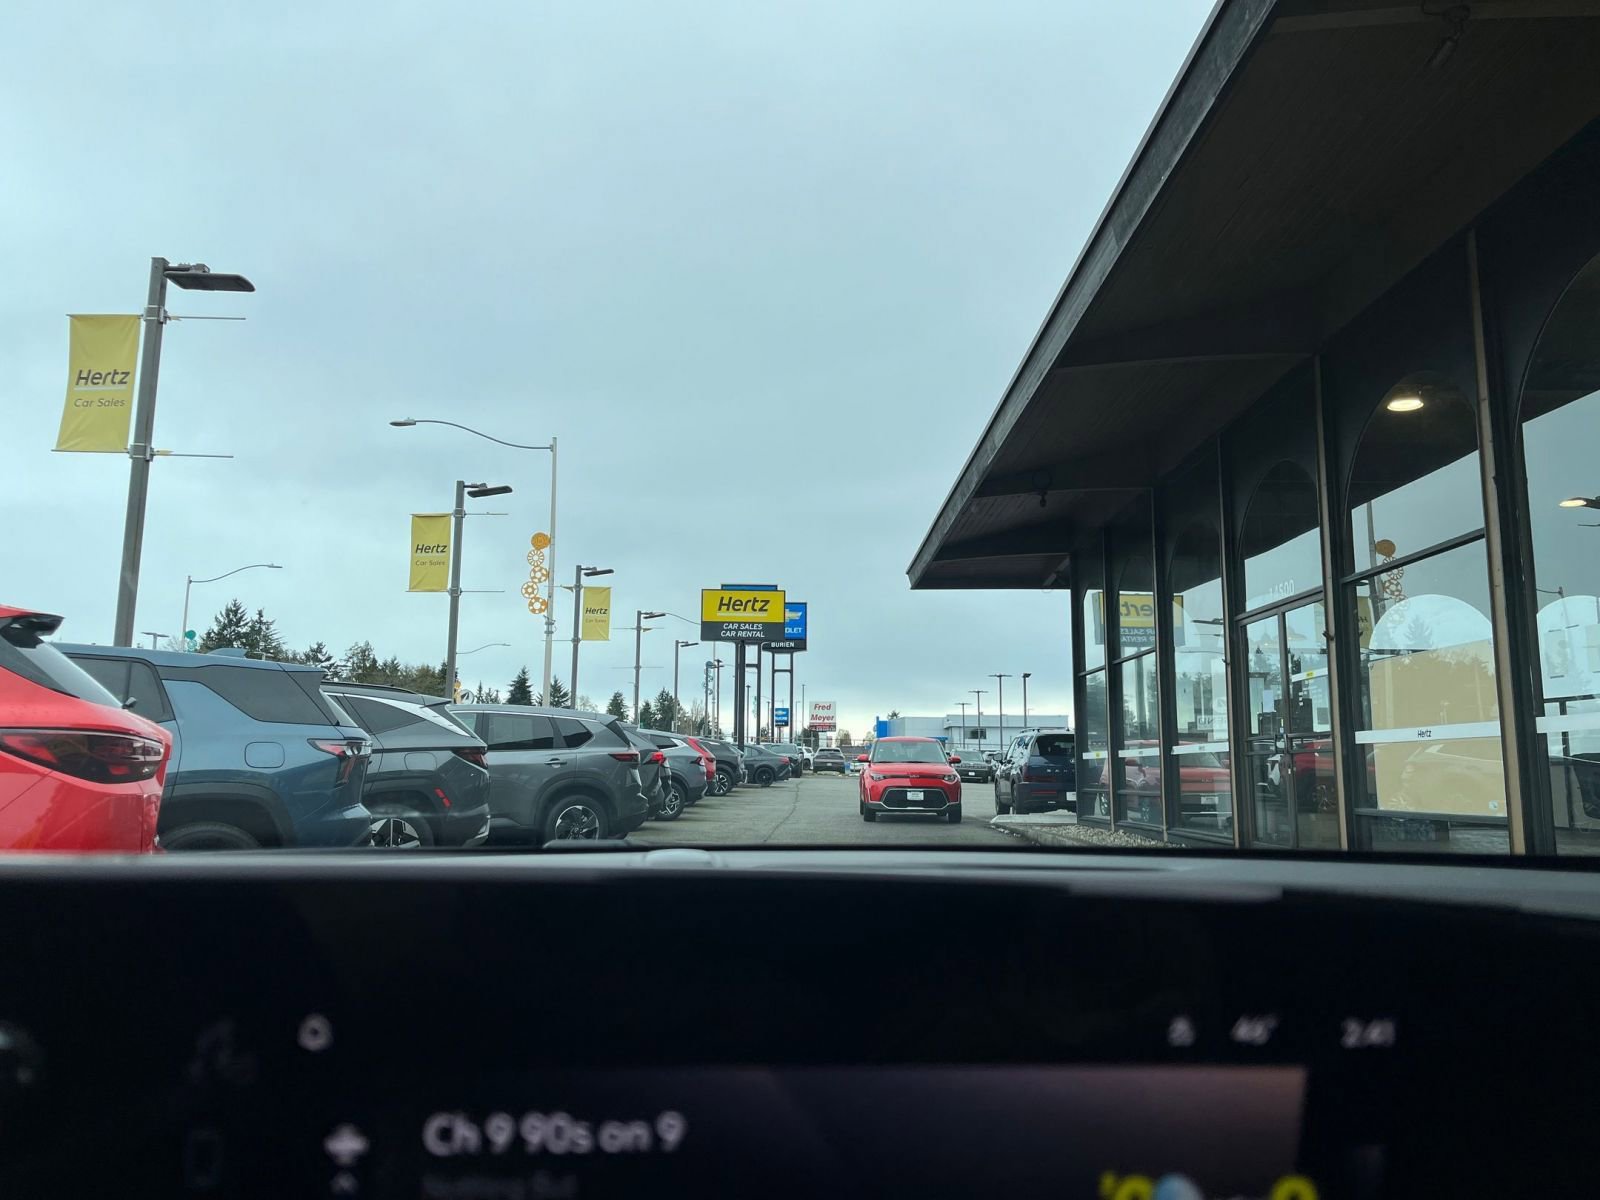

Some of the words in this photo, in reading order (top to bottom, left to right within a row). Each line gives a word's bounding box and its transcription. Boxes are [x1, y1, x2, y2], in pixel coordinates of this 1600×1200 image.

[75, 369, 130, 386] Hertz
[73, 398, 94, 408] Car
[97, 398, 126, 408] Sales
[415, 543, 447, 554] Hertz
[717, 596, 770, 612] Hertz
[585, 607, 608, 615] Hertz
[737, 630, 765, 638] RENTAL
[814, 703, 831, 711] Fred
[810, 713, 834, 721] Meyer
[1417, 729, 1432, 738] Hertz
[422, 1111, 481, 1157] Ch
[599, 1119, 651, 1153] on
[656, 1110, 687, 1153] 9
